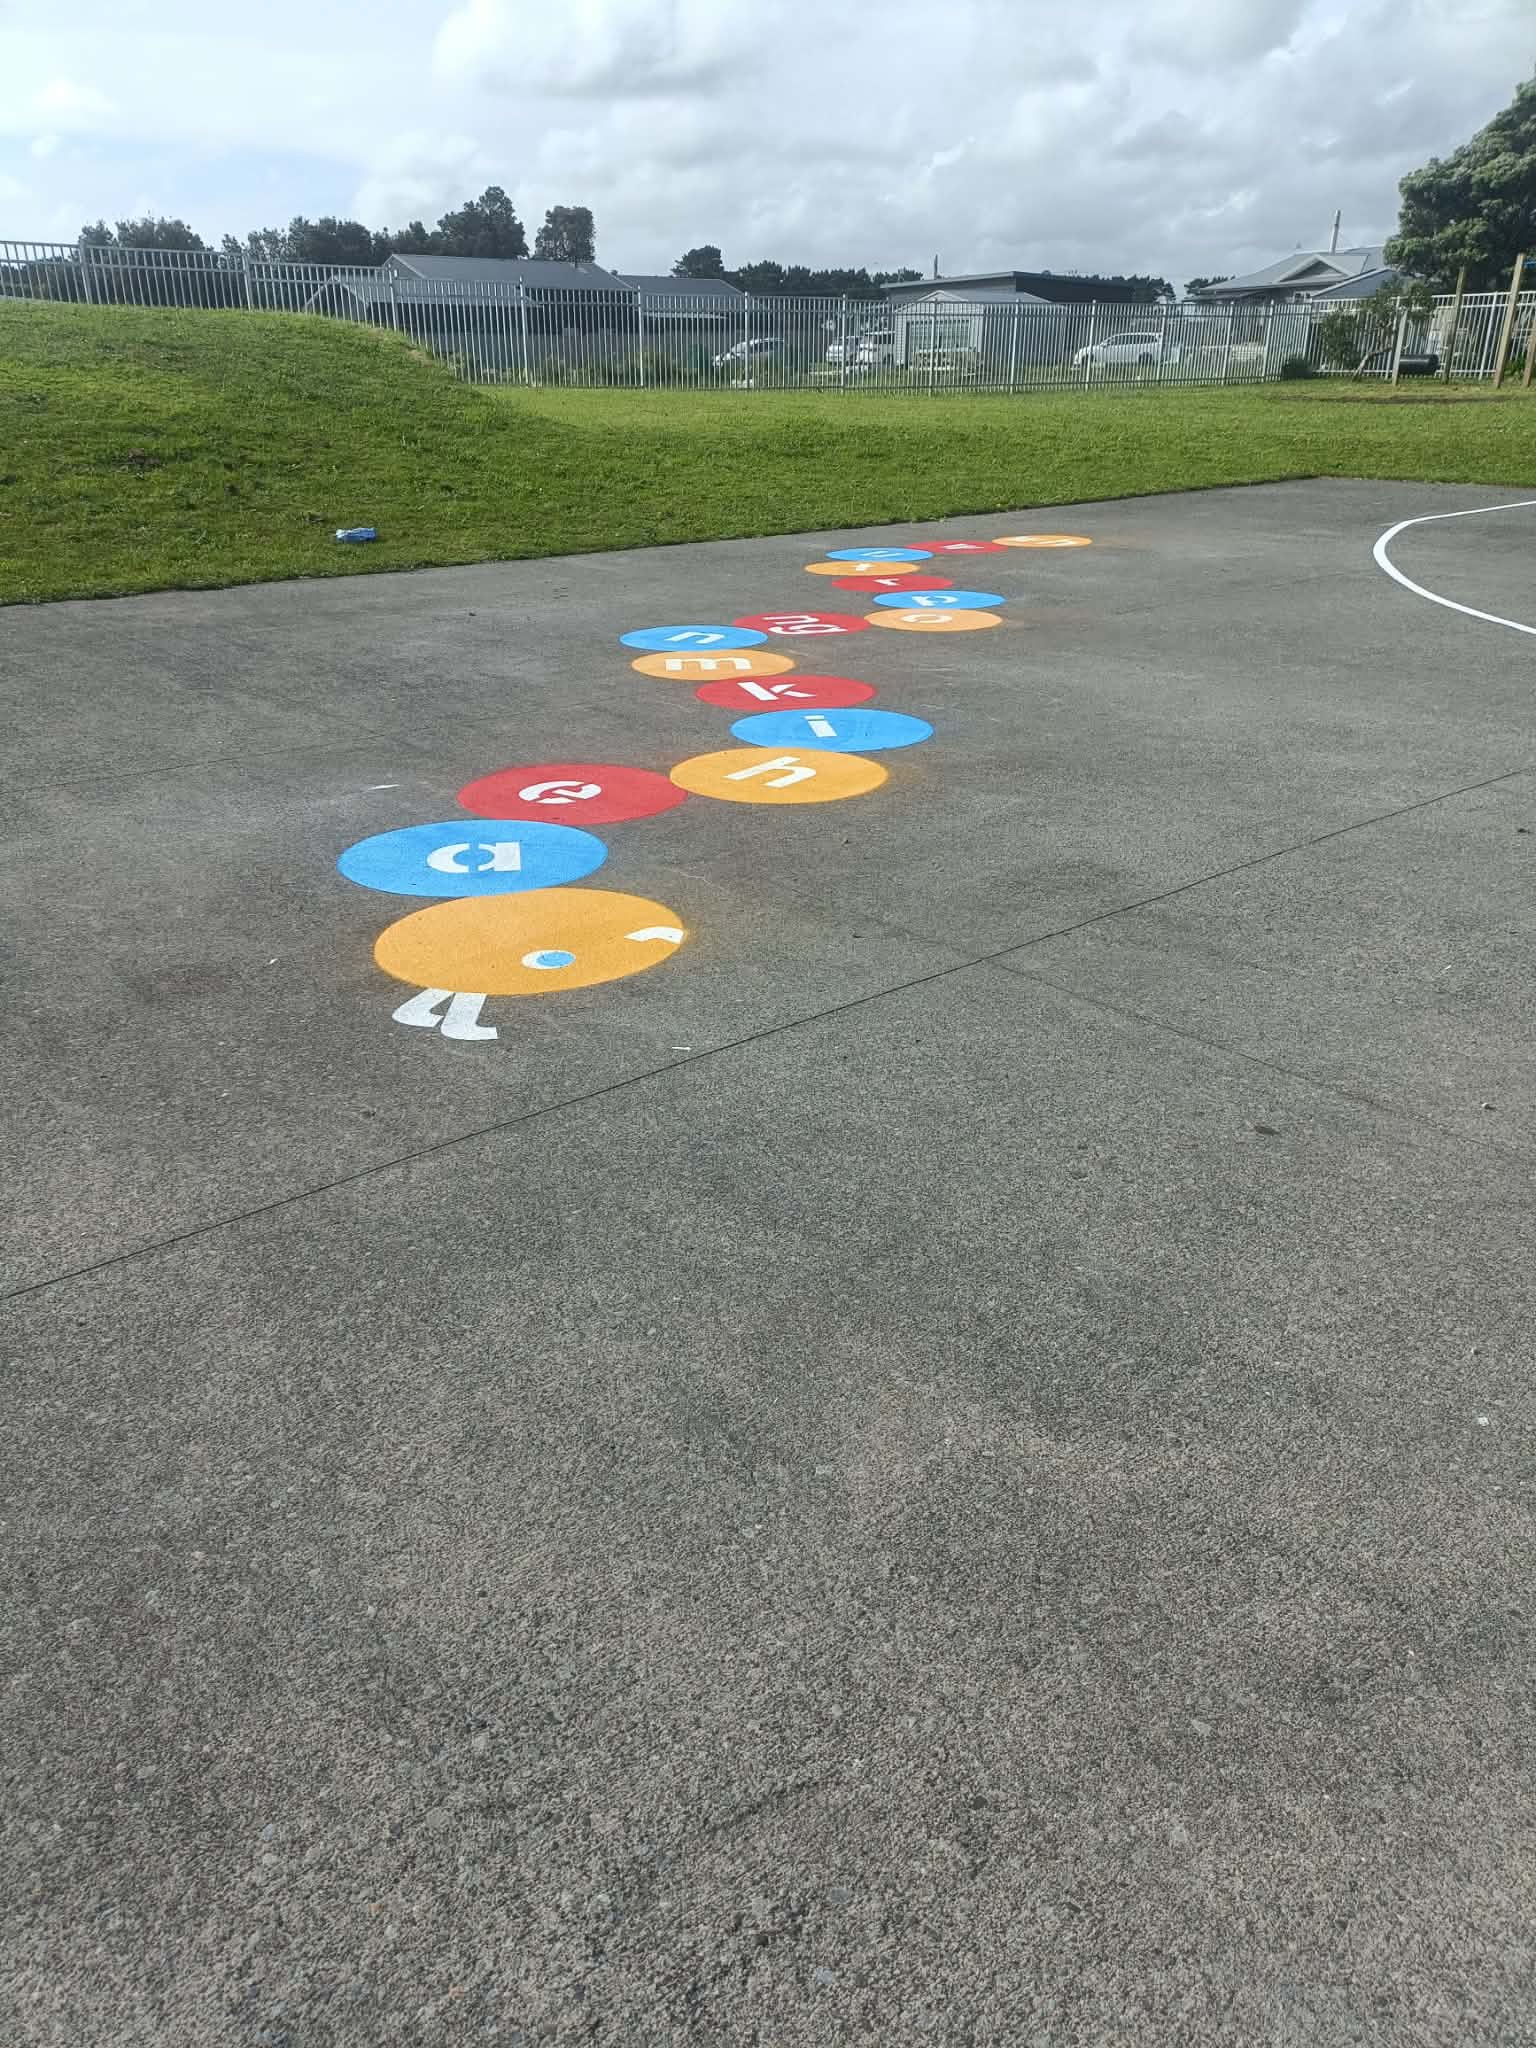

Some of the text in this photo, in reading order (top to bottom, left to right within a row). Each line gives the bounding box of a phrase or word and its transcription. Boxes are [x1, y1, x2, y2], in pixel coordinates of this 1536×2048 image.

[873, 578, 899, 587] r
[911, 594, 958, 608] p
[762, 614, 849, 635] ng
[900, 612, 953, 624] o
[666, 632, 724, 644] n
[665, 656, 752, 673] m
[737, 682, 816, 701] k
[805, 715, 837, 737] i
[725, 756, 816, 788] h
[519, 781, 602, 804] e
[427, 841, 521, 873] a
